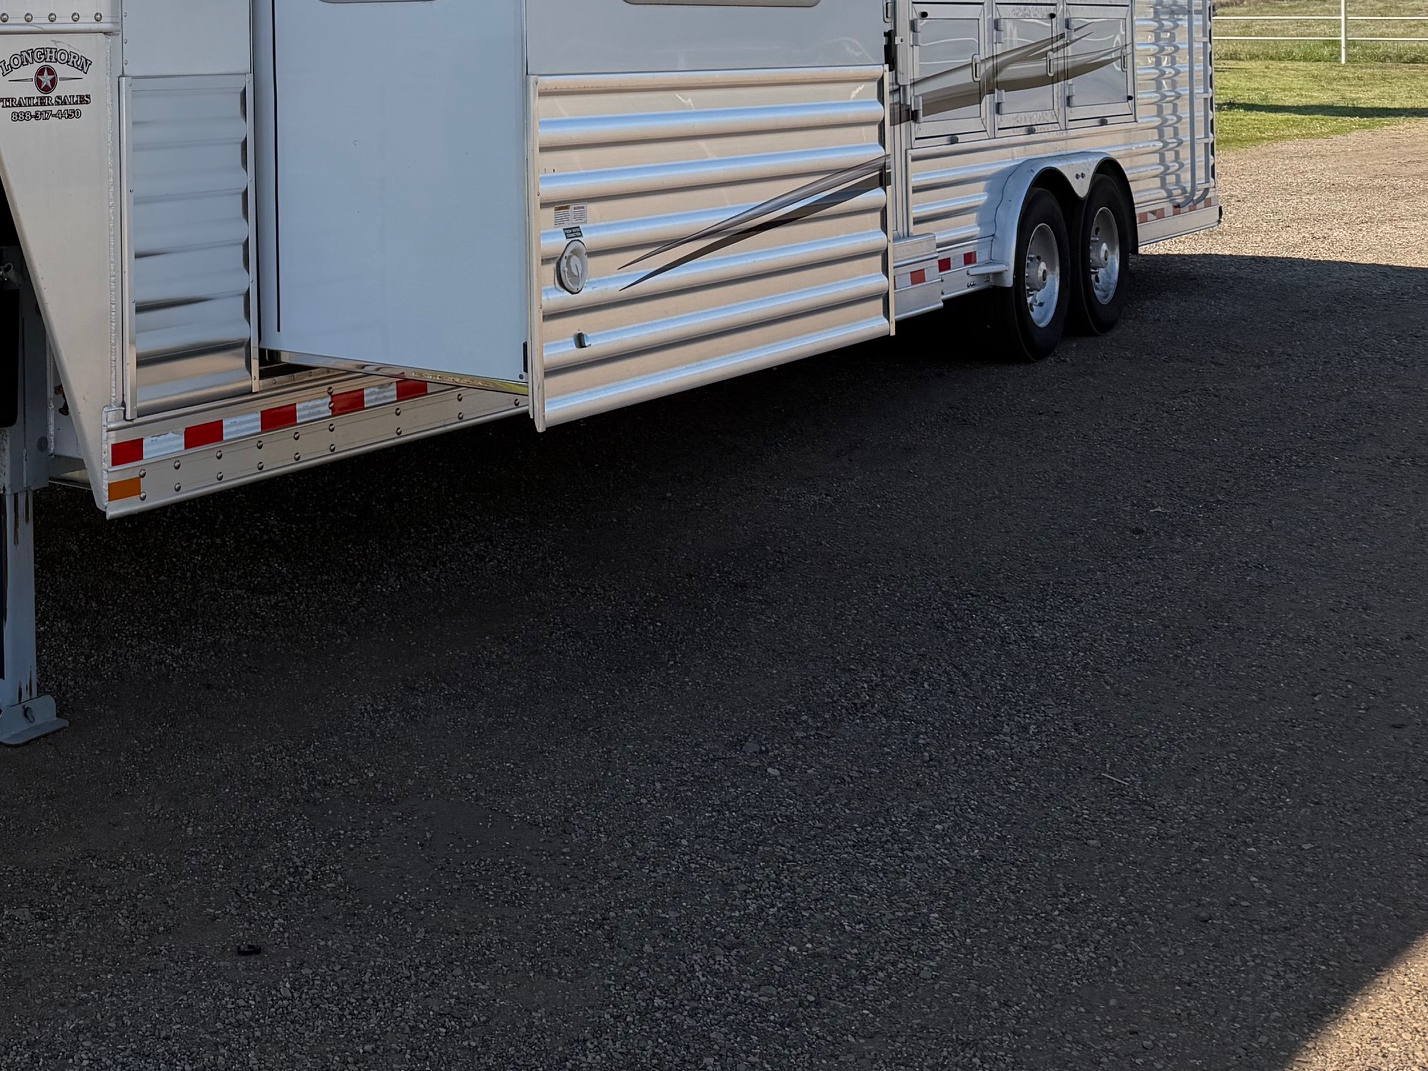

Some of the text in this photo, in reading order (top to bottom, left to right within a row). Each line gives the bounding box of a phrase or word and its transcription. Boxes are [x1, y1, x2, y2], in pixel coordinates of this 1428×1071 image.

[0, 94, 91, 108] TRAILER SALES
[11, 109, 82, 122] 888-317-4450
